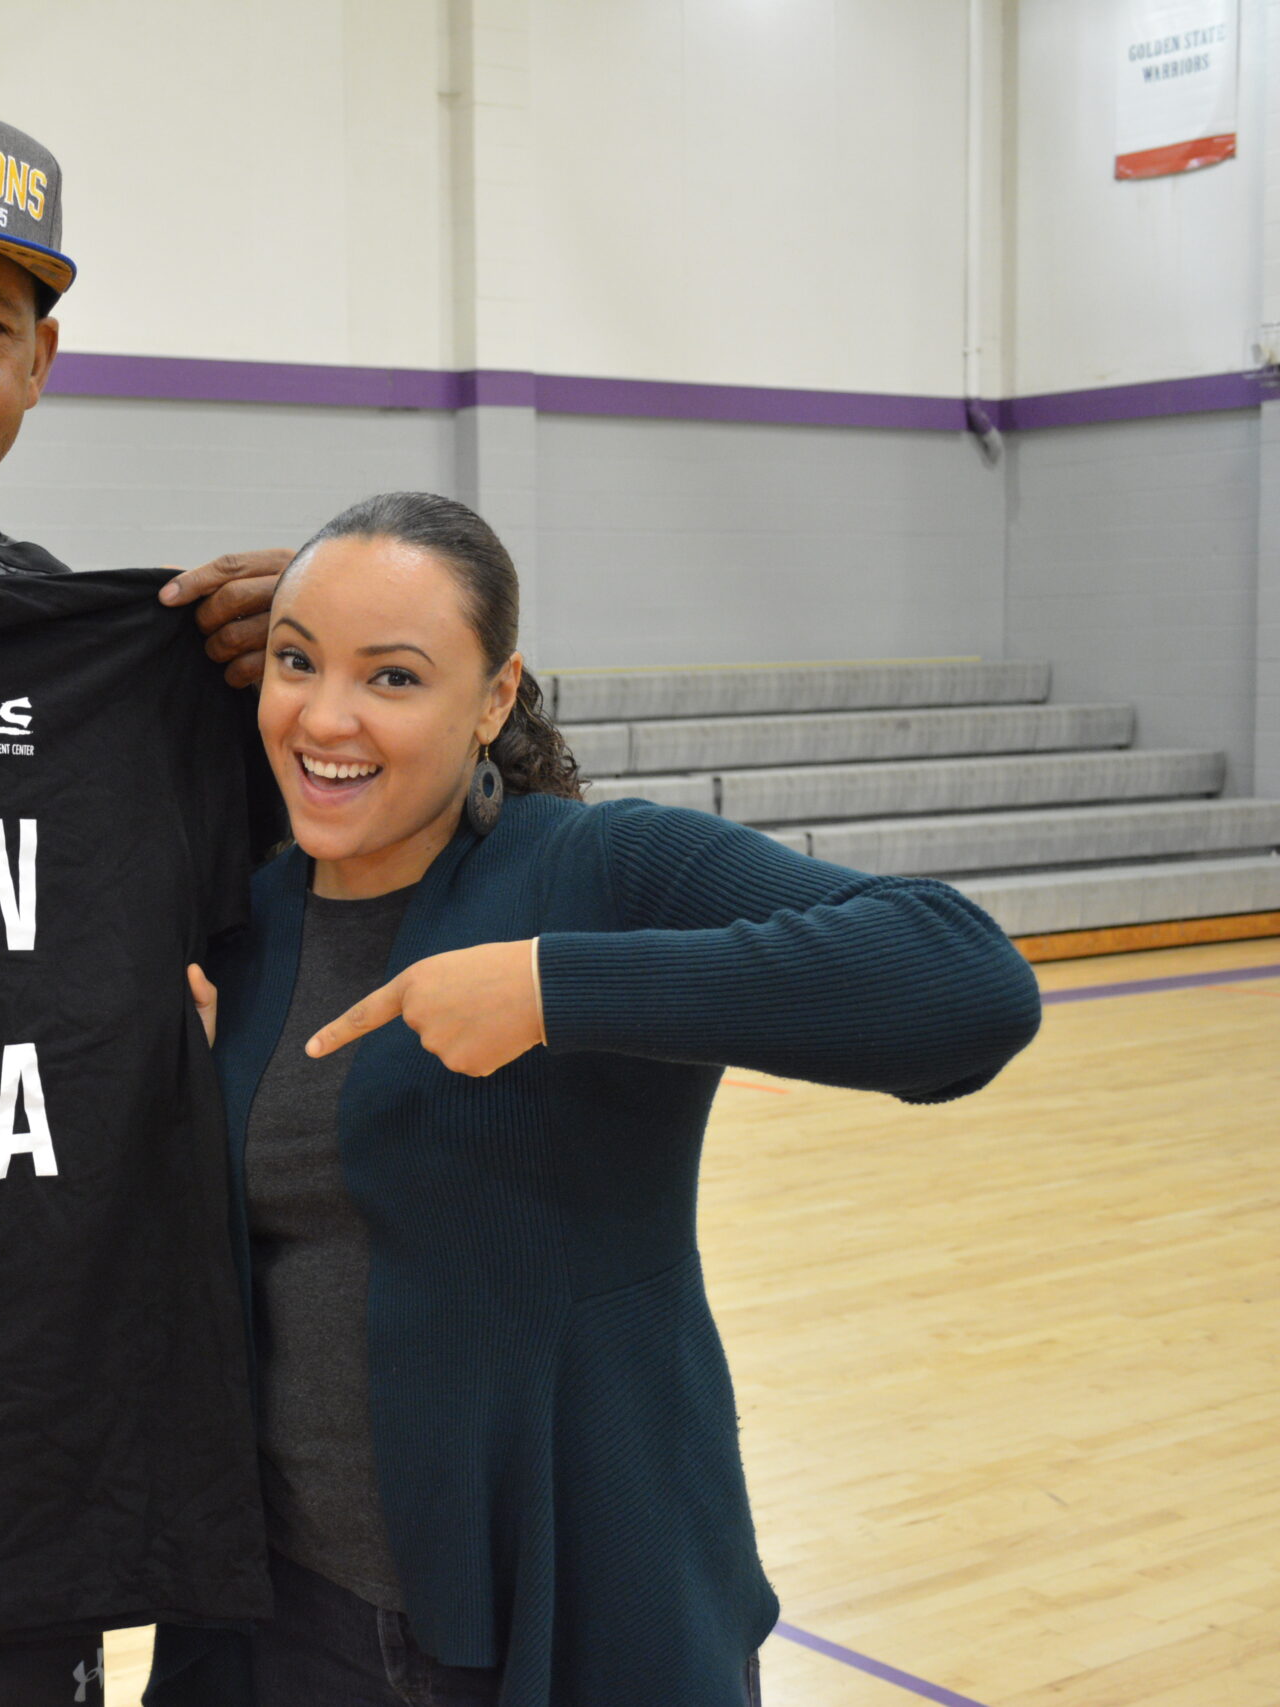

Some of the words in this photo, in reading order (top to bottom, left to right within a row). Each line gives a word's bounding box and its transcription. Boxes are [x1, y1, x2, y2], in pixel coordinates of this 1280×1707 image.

[1128, 35, 1180, 62] GOLDEN
[1184, 24, 1226, 49] STATE
[1142, 53, 1210, 83] WARRIORS
[12, 743, 35, 756] CENTER
